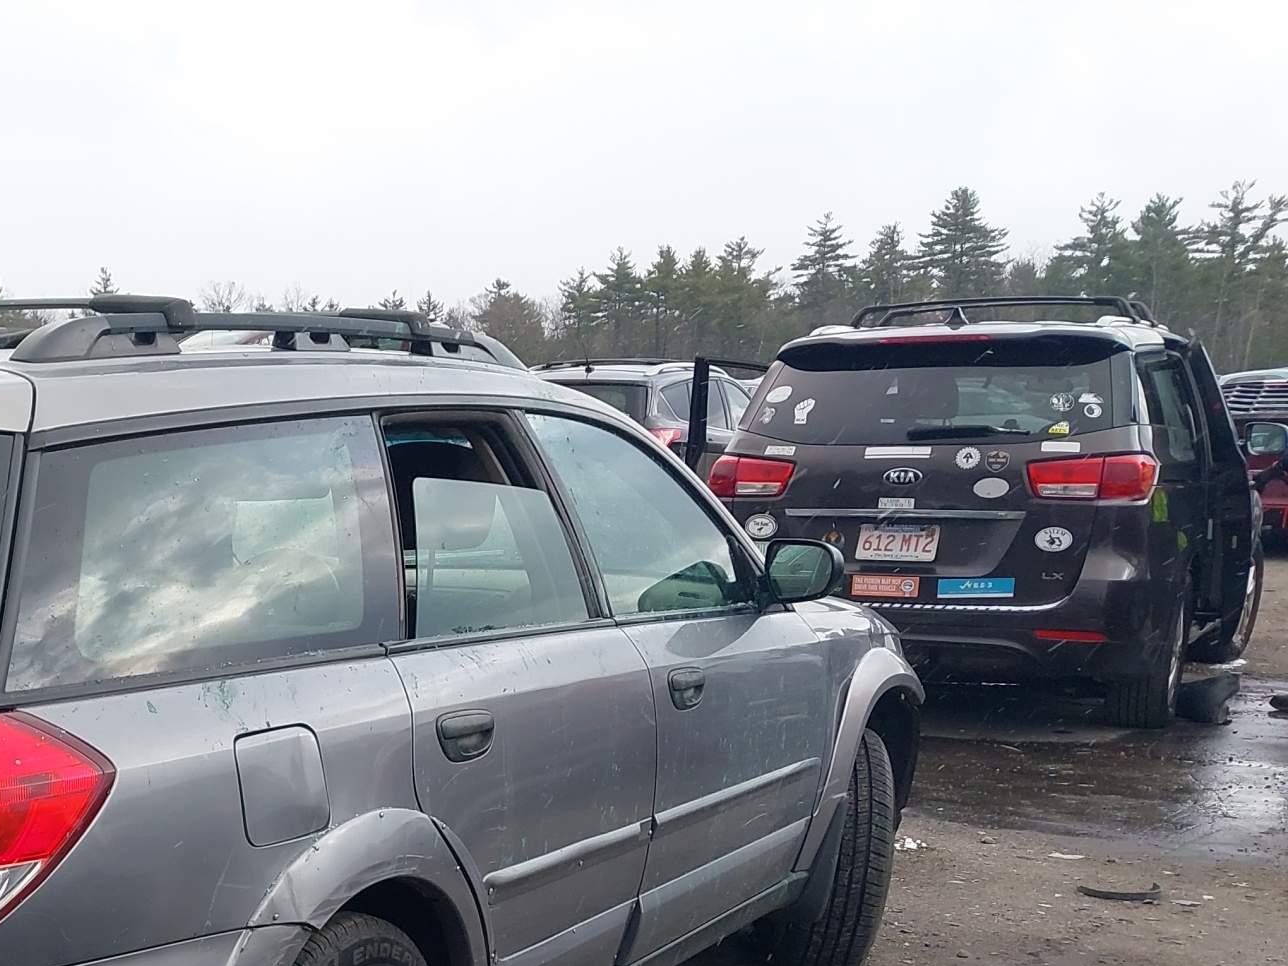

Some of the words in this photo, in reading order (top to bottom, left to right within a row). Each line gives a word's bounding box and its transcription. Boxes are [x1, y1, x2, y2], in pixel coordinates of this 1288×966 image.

[888, 471, 916, 483] KIA
[862, 533, 896, 552] 612
[899, 533, 935, 553] MT2
[1041, 572, 1065, 580] LX
